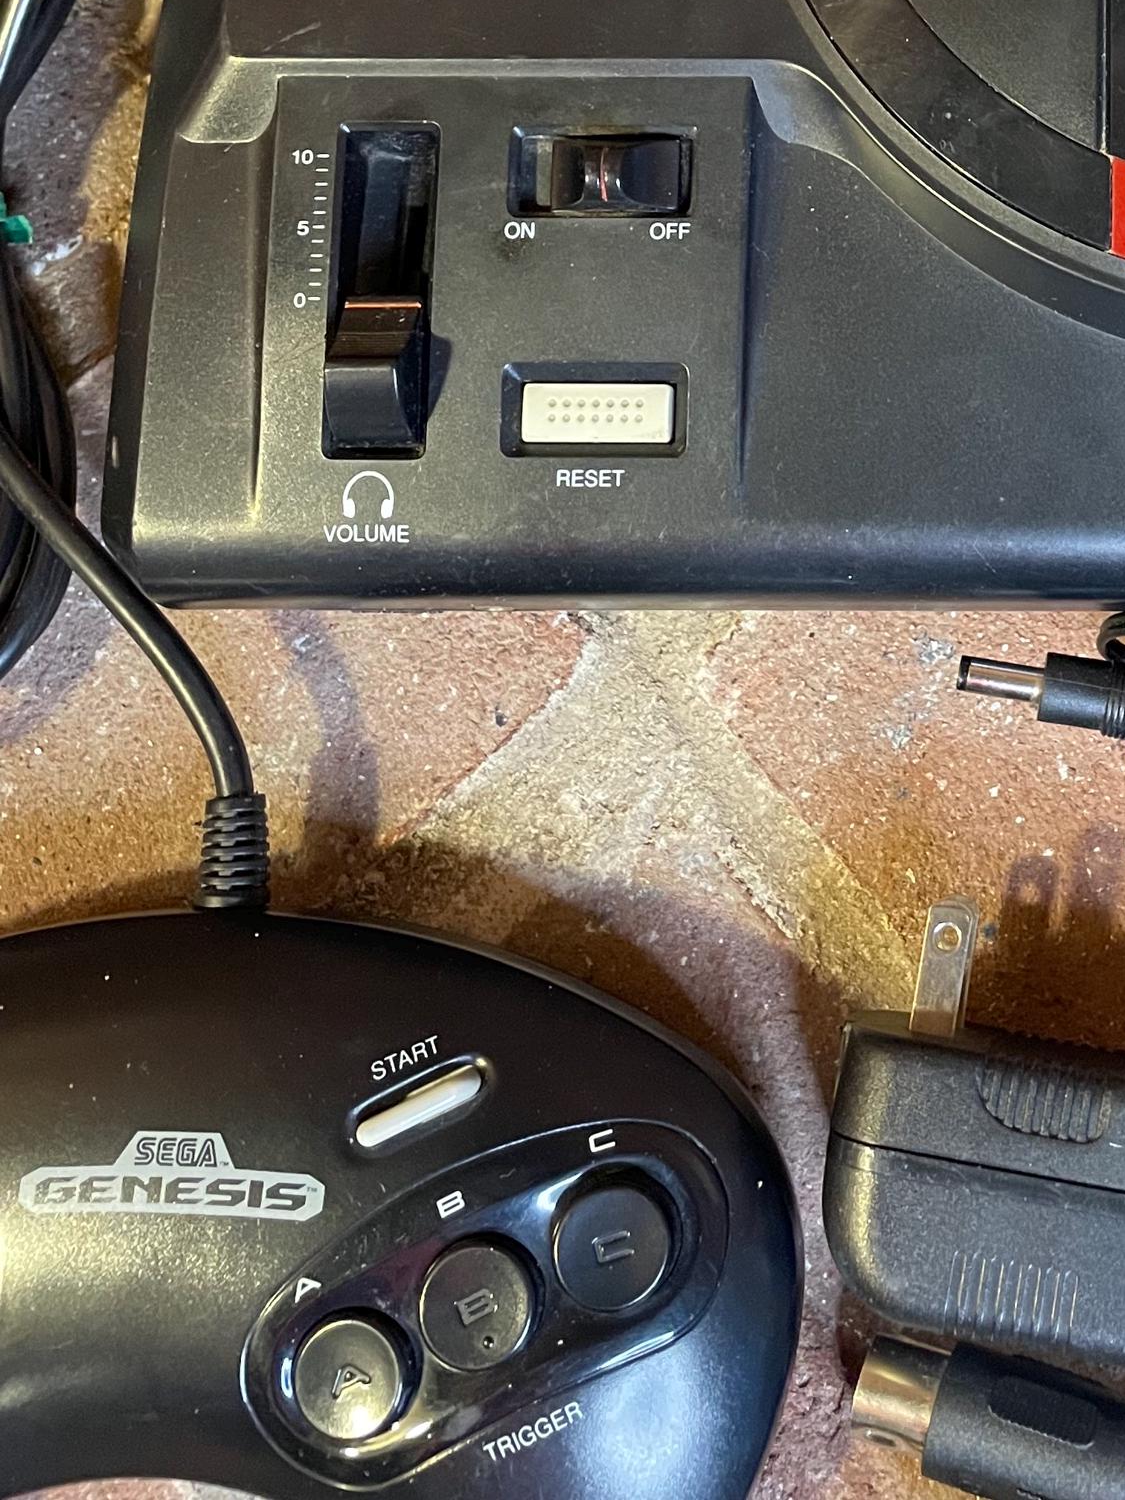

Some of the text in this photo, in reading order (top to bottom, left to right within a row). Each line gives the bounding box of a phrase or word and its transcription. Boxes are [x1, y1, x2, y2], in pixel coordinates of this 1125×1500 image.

[292, 149, 314, 165] 10
[296, 220, 311, 236] 5
[503, 221, 692, 240] ON OFF
[555, 468, 626, 488] RESET
[322, 524, 410, 544] VOLUME
[370, 1035, 440, 1082] START
[134, 1136, 218, 1168] SEGA
[588, 1129, 616, 1153] C
[35, 1175, 306, 1211] GENESIS
[436, 1190, 466, 1219] B
[294, 1277, 322, 1303] A
[482, 1401, 584, 1462] TRIGGER
